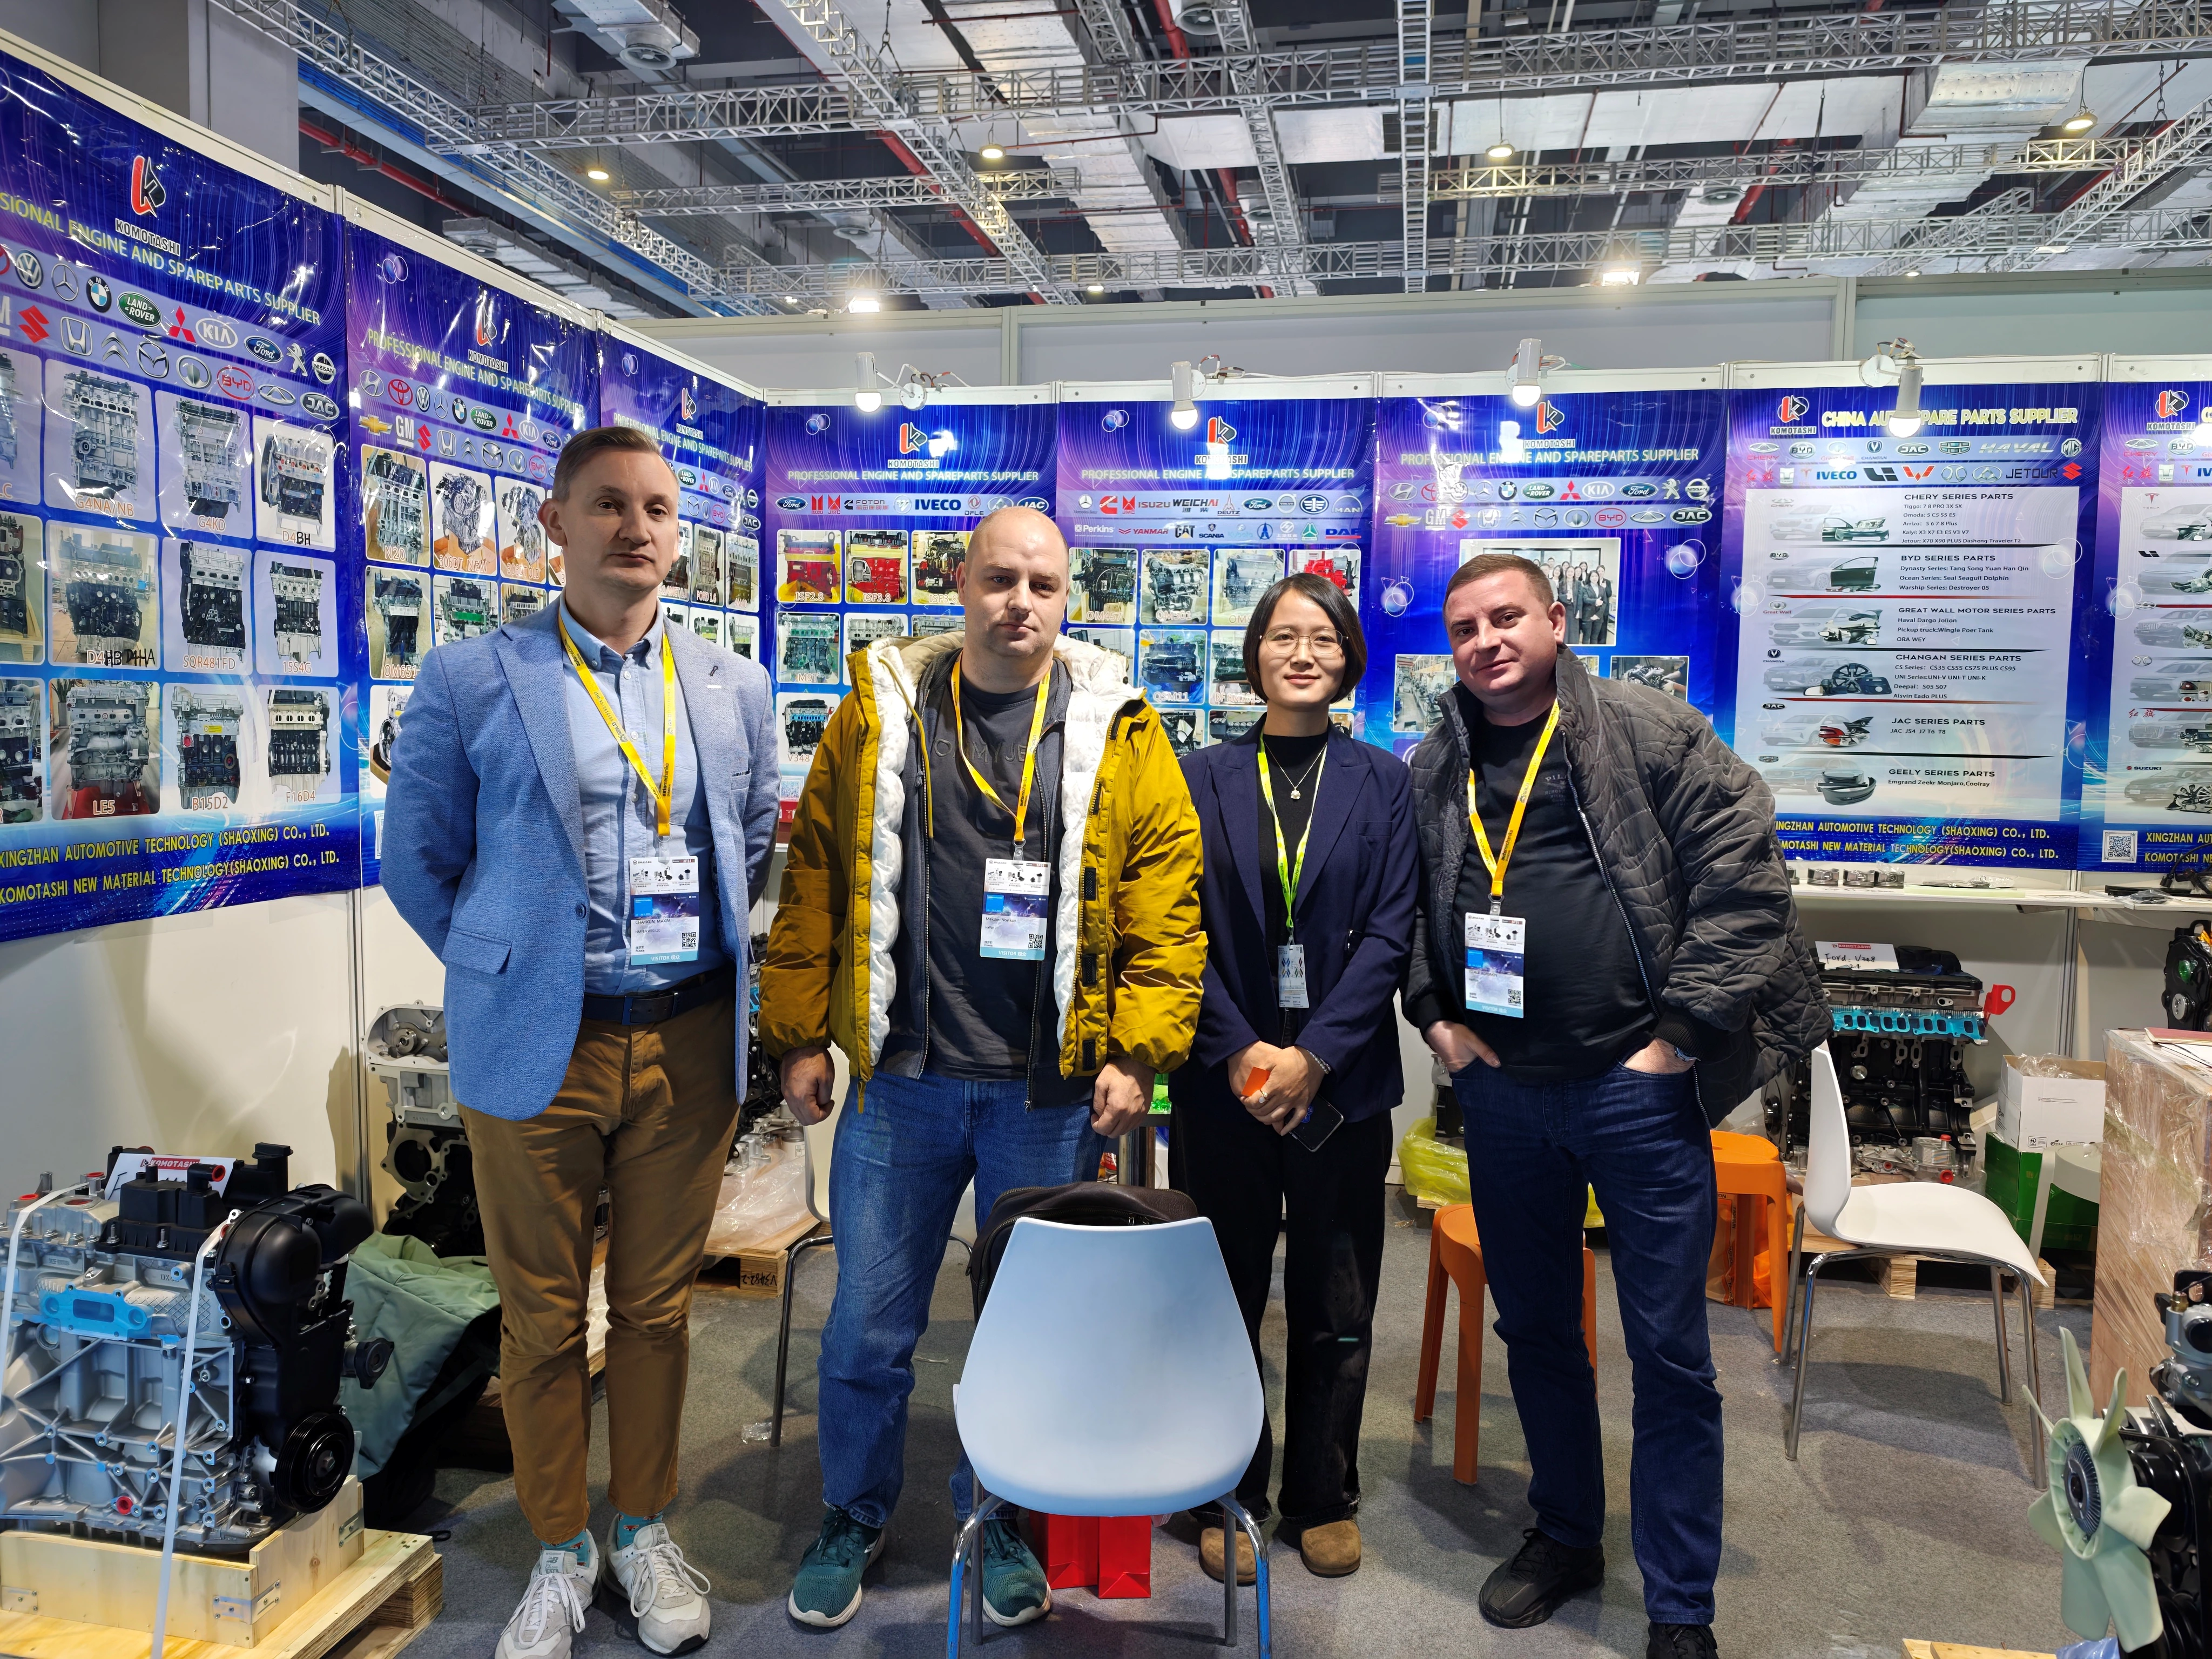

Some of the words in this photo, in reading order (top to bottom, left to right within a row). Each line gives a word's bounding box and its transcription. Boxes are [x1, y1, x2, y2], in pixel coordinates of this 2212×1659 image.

[115, 218, 180, 257] KOMOTASHI
[69, 220, 127, 257] ENGINE
[132, 245, 164, 269] AND
[168, 259, 261, 303] SPAREPARTS
[265, 292, 321, 326] SUPPLIER
[126, 297, 148, 311] LAND
[129, 308, 155, 322] ROVER
[203, 322, 232, 345] KIA
[254, 340, 275, 359] Ford
[368, 328, 442, 368] PROFESSIONAL
[444, 356, 476, 382] ENGINE
[477, 367, 498, 387] AND
[468, 349, 509, 373] KOMOTASHI
[314, 363, 334, 373] NISSAN
[222, 375, 251, 392] BYD
[306, 396, 334, 416] JAC
[1822, 410, 1867, 427] CHINA
[1961, 408, 2006, 424] PARTS
[2009, 408, 2078, 424] SUPPLIER
[395, 415, 414, 440] GM
[676, 423, 704, 440] KOMOTASHI
[1770, 426, 1817, 435] KOMOTASHI
[2147, 422, 2196, 430] KOMOTASHI
[683, 439, 697, 453] AND
[1524, 439, 1575, 449] KOMOTASHI
[1979, 442, 2054, 453] HAVAL
[1535, 451, 1561, 463] AND
[1564, 449, 1639, 462] SPAREPARTS
[1642, 448, 1699, 461] SUPPLIER
[887, 459, 939, 469] KOMOTASHI
[788, 470, 860, 480] PROFESSIONAL
[862, 470, 899, 480] ENGINE
[901, 471, 923, 480] AND
[926, 471, 989, 481] SPAREPARTS
[991, 471, 1039, 481] SUPPLIER
[1082, 470, 1160, 479] PROFESSIONAL
[1163, 470, 1202, 478] ENGINE
[1231, 469, 1300, 478] SPAREPARTS
[1303, 468, 1354, 478] SUPPLIER
[1816, 470, 1857, 480] IVECO
[2006, 468, 2058, 478] JETOUR
[1588, 486, 1609, 494] KIA
[1628, 486, 1649, 495] Ford
[75, 494, 135, 518] G4NA/NB
[783, 500, 800, 508] Ford
[915, 499, 961, 510] IVECO
[198, 515, 226, 531] G4KD
[1083, 524, 1114, 533] Perkins
[1175, 525, 1195, 538] CAT
[384, 547, 406, 561] N20
[439, 555, 463, 572] 306DT
[468, 557, 488, 572] NEW
[528, 567, 540, 580] OLD
[795, 591, 824, 602] ISF2.8
[863, 592, 891, 603] ISF3.8
[929, 594, 958, 603] ISF3.8
[1086, 611, 1123, 621] OM457
[1156, 611, 1192, 621] OM501
[183, 655, 236, 671] SQR481FD
[282, 660, 312, 674] 15S4G
[384, 665, 417, 678] OM651
[798, 673, 818, 682] M9T
[1153, 691, 1189, 701] QSM11
[787, 753, 810, 763] V348
[192, 795, 229, 812] B15D2
[286, 791, 316, 803] F16D4
[93, 799, 116, 815] LE5
[1817, 822, 1874, 833] AUTOMOTIVE
[1878, 824, 1937, 835] TECHNOLOGY
[1941, 826, 1998, 838] (SHAOXING)
[2002, 827, 2026, 839] CO.,
[2030, 828, 2050, 839] LTD.
[65, 838, 139, 862] AUTOMOTIVE
[145, 832, 214, 854] TECHNOLOGY
[219, 825, 278, 847] (SHAOXING)
[283, 825, 307, 841] CO.,
[310, 822, 330, 838] LTD.
[2146, 832, 2193, 843] XINGZHAN
[1823, 842, 1841, 851] NEW
[1845, 842, 1886, 852] MATERIAL
[0, 880, 68, 905] KOMOTASHI
[73, 876, 97, 894] NEW
[102, 868, 157, 891] MATERIAL
[293, 853, 318, 867] CO.,
[320, 851, 340, 864] LTD.
